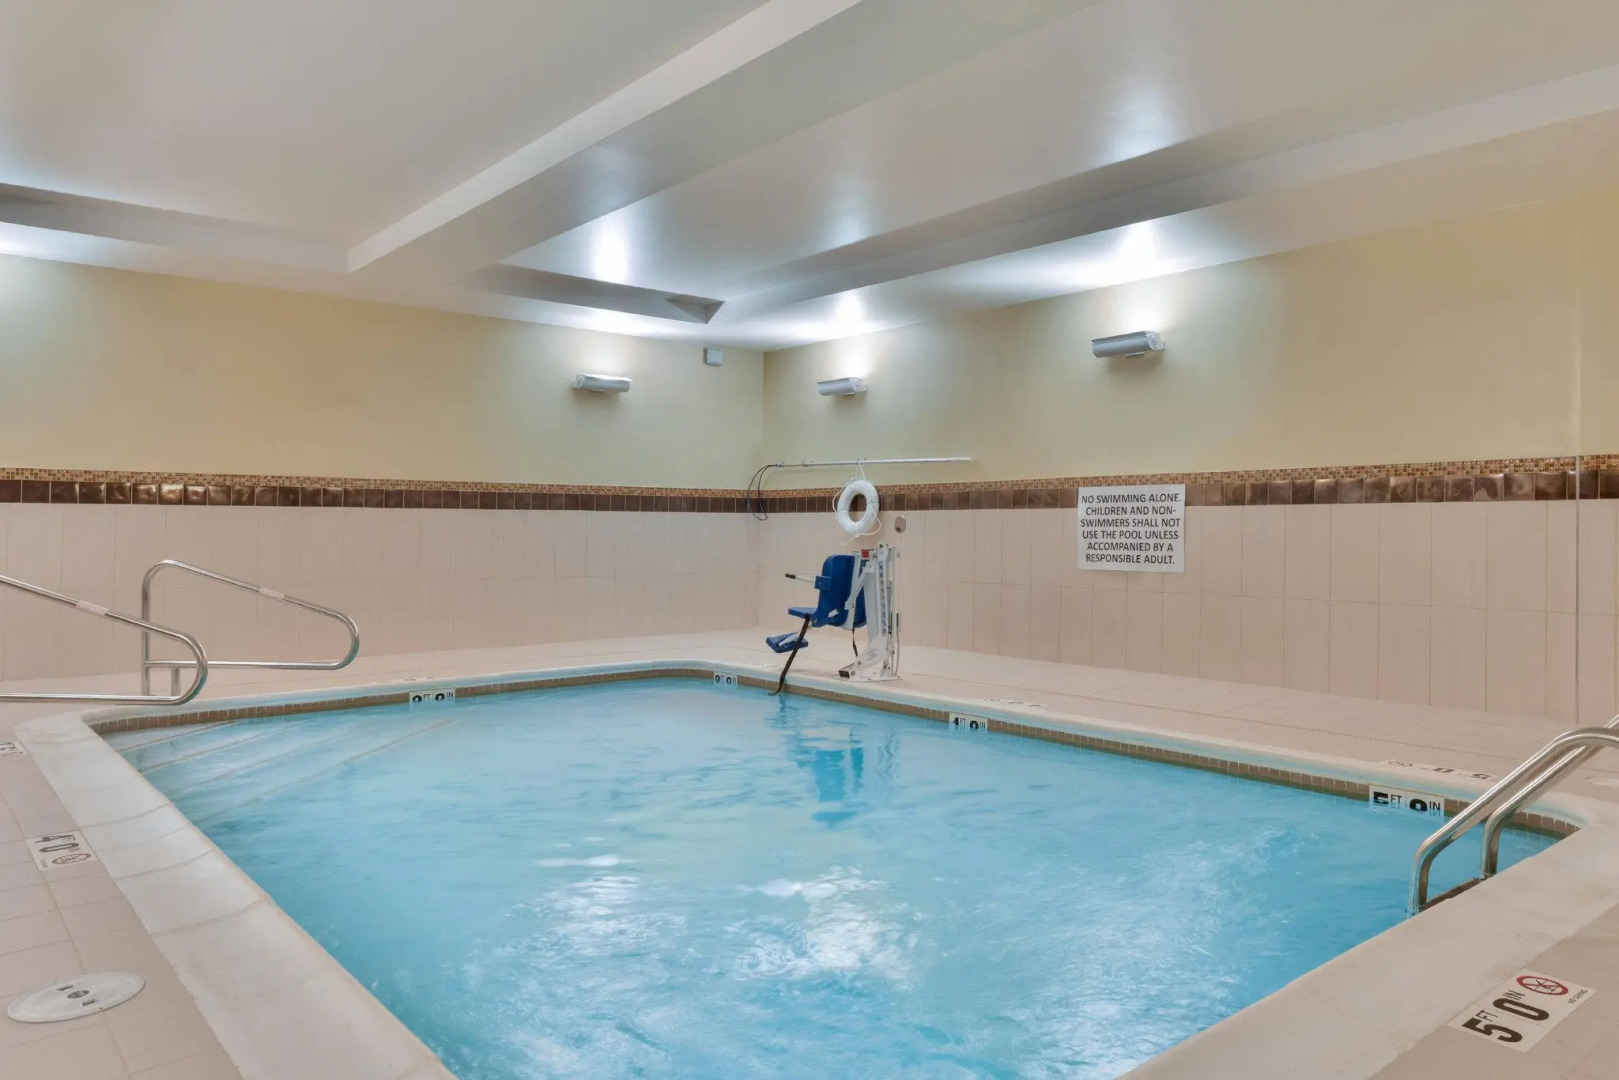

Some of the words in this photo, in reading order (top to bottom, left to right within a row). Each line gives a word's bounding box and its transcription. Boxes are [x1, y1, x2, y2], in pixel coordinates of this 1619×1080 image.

[1081, 495, 1094, 503] NO
[1097, 494, 1146, 503] SWIMMING
[1149, 493, 1181, 502] ALONE.
[1086, 507, 1127, 515] CHILDREN
[1130, 507, 1149, 515] AND
[1152, 506, 1176, 514] NON-
[1080, 519, 1130, 527] SWIMMERS
[1132, 519, 1158, 527] SHALL
[1161, 518, 1180, 527] NOT
[1082, 531, 1098, 539] USE
[1101, 531, 1117, 539] THE
[1119, 531, 1142, 539] POOL
[1145, 531, 1179, 539] UNLESS
[1087, 542, 1150, 551] ACCOMPANIED
[1153, 543, 1164, 551] BY
[1167, 543, 1173, 551] A
[1086, 554, 1141, 563] RESPONSIBLE
[1144, 555, 1175, 564] ADULT.
